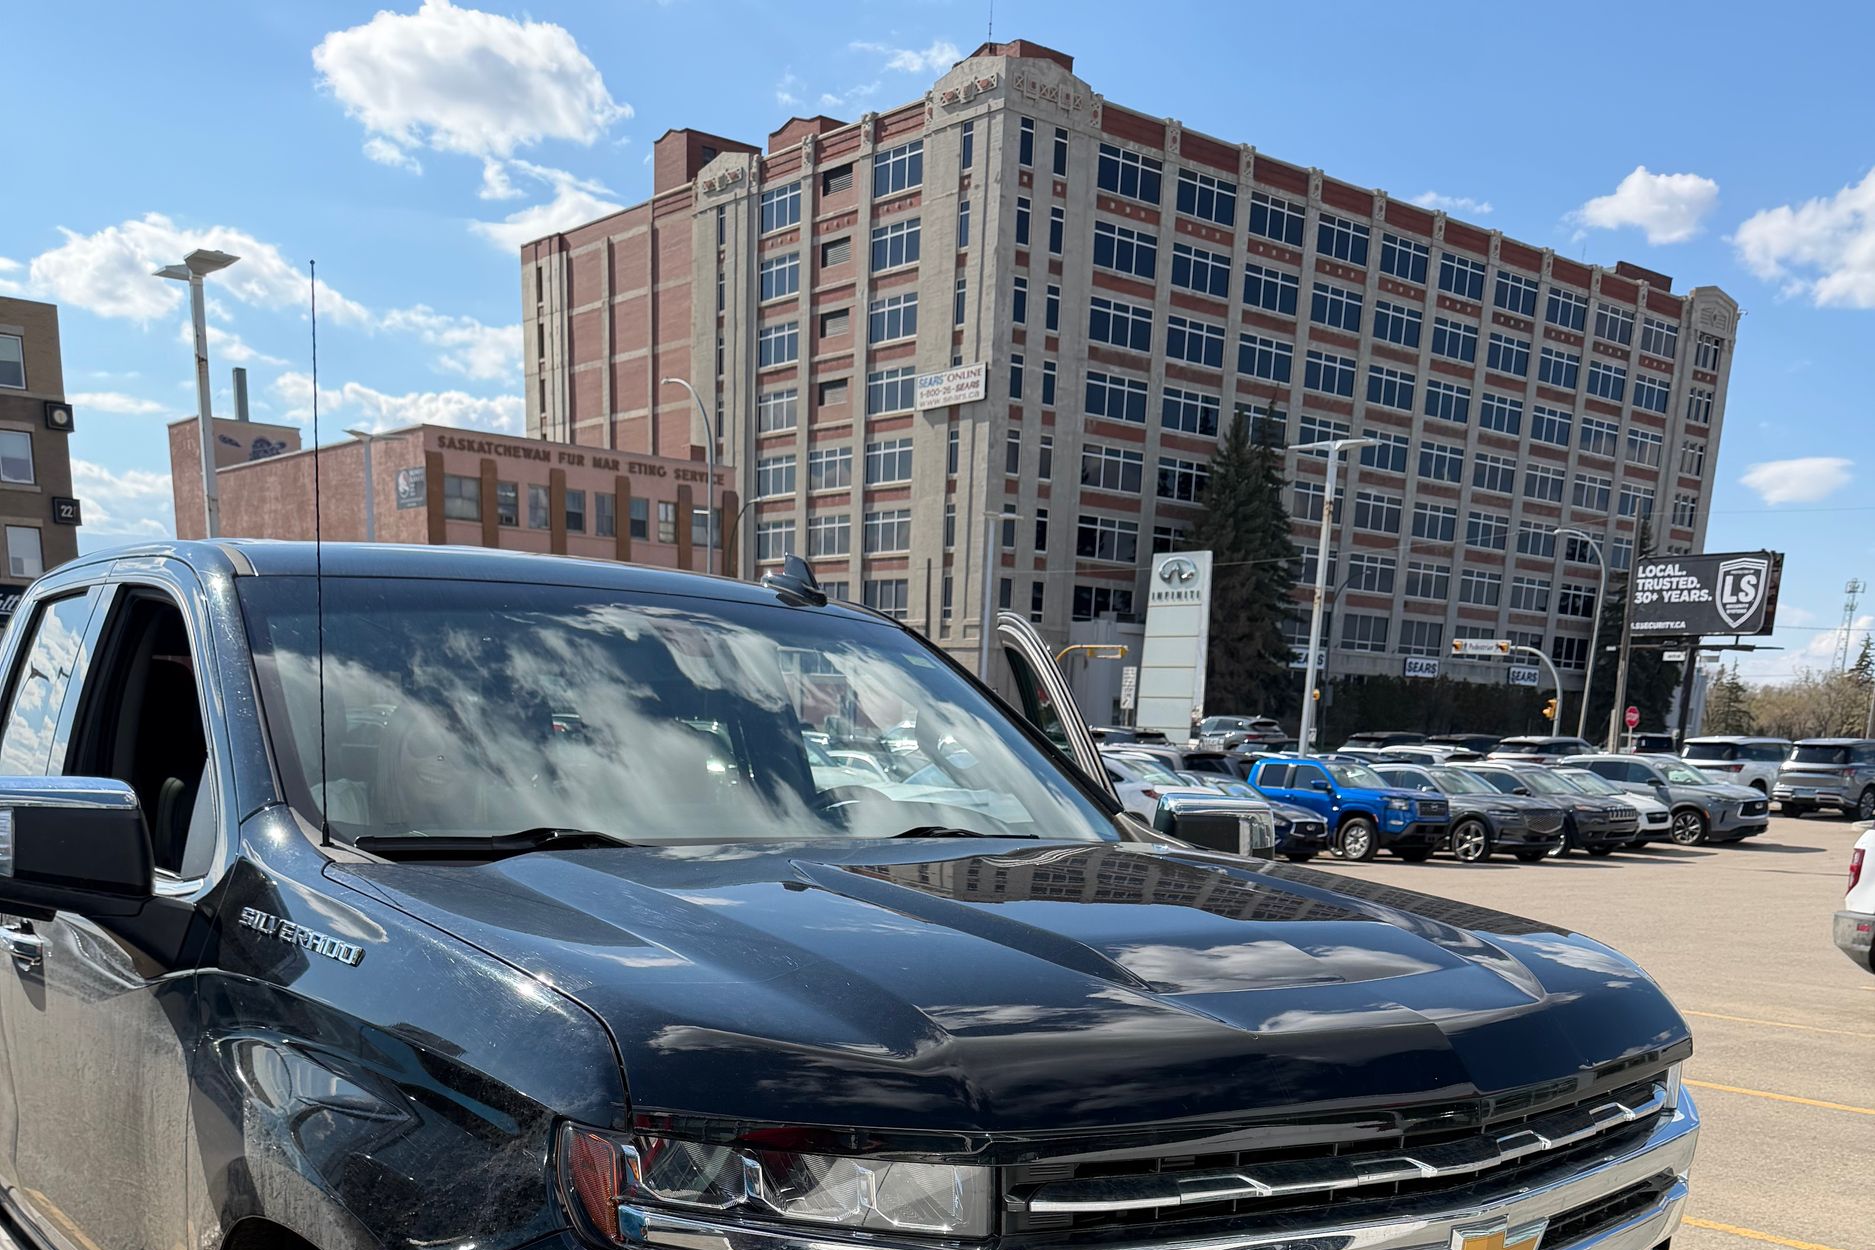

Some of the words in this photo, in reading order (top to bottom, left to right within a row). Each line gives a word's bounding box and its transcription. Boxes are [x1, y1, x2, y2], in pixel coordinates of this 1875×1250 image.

[919, 375, 944, 388] SEARS
[947, 368, 982, 382] ONLINE
[920, 391, 980, 407] www.sears.ca
[437, 435, 550, 463] SASKATCHEWAN
[558, 451, 585, 467] FUR
[1637, 564, 1687, 578] LOCAL.
[1636, 576, 1701, 591] TRUSTED.
[1722, 574, 1758, 603] LS
[1151, 590, 1200, 601] INFINITI
[1633, 591, 1659, 604] 30+
[1662, 589, 1713, 603] YEARS.
[1407, 660, 1437, 675] SEARS
[1511, 670, 1538, 684] SEARS
[239, 906, 366, 967] SILVERADO
